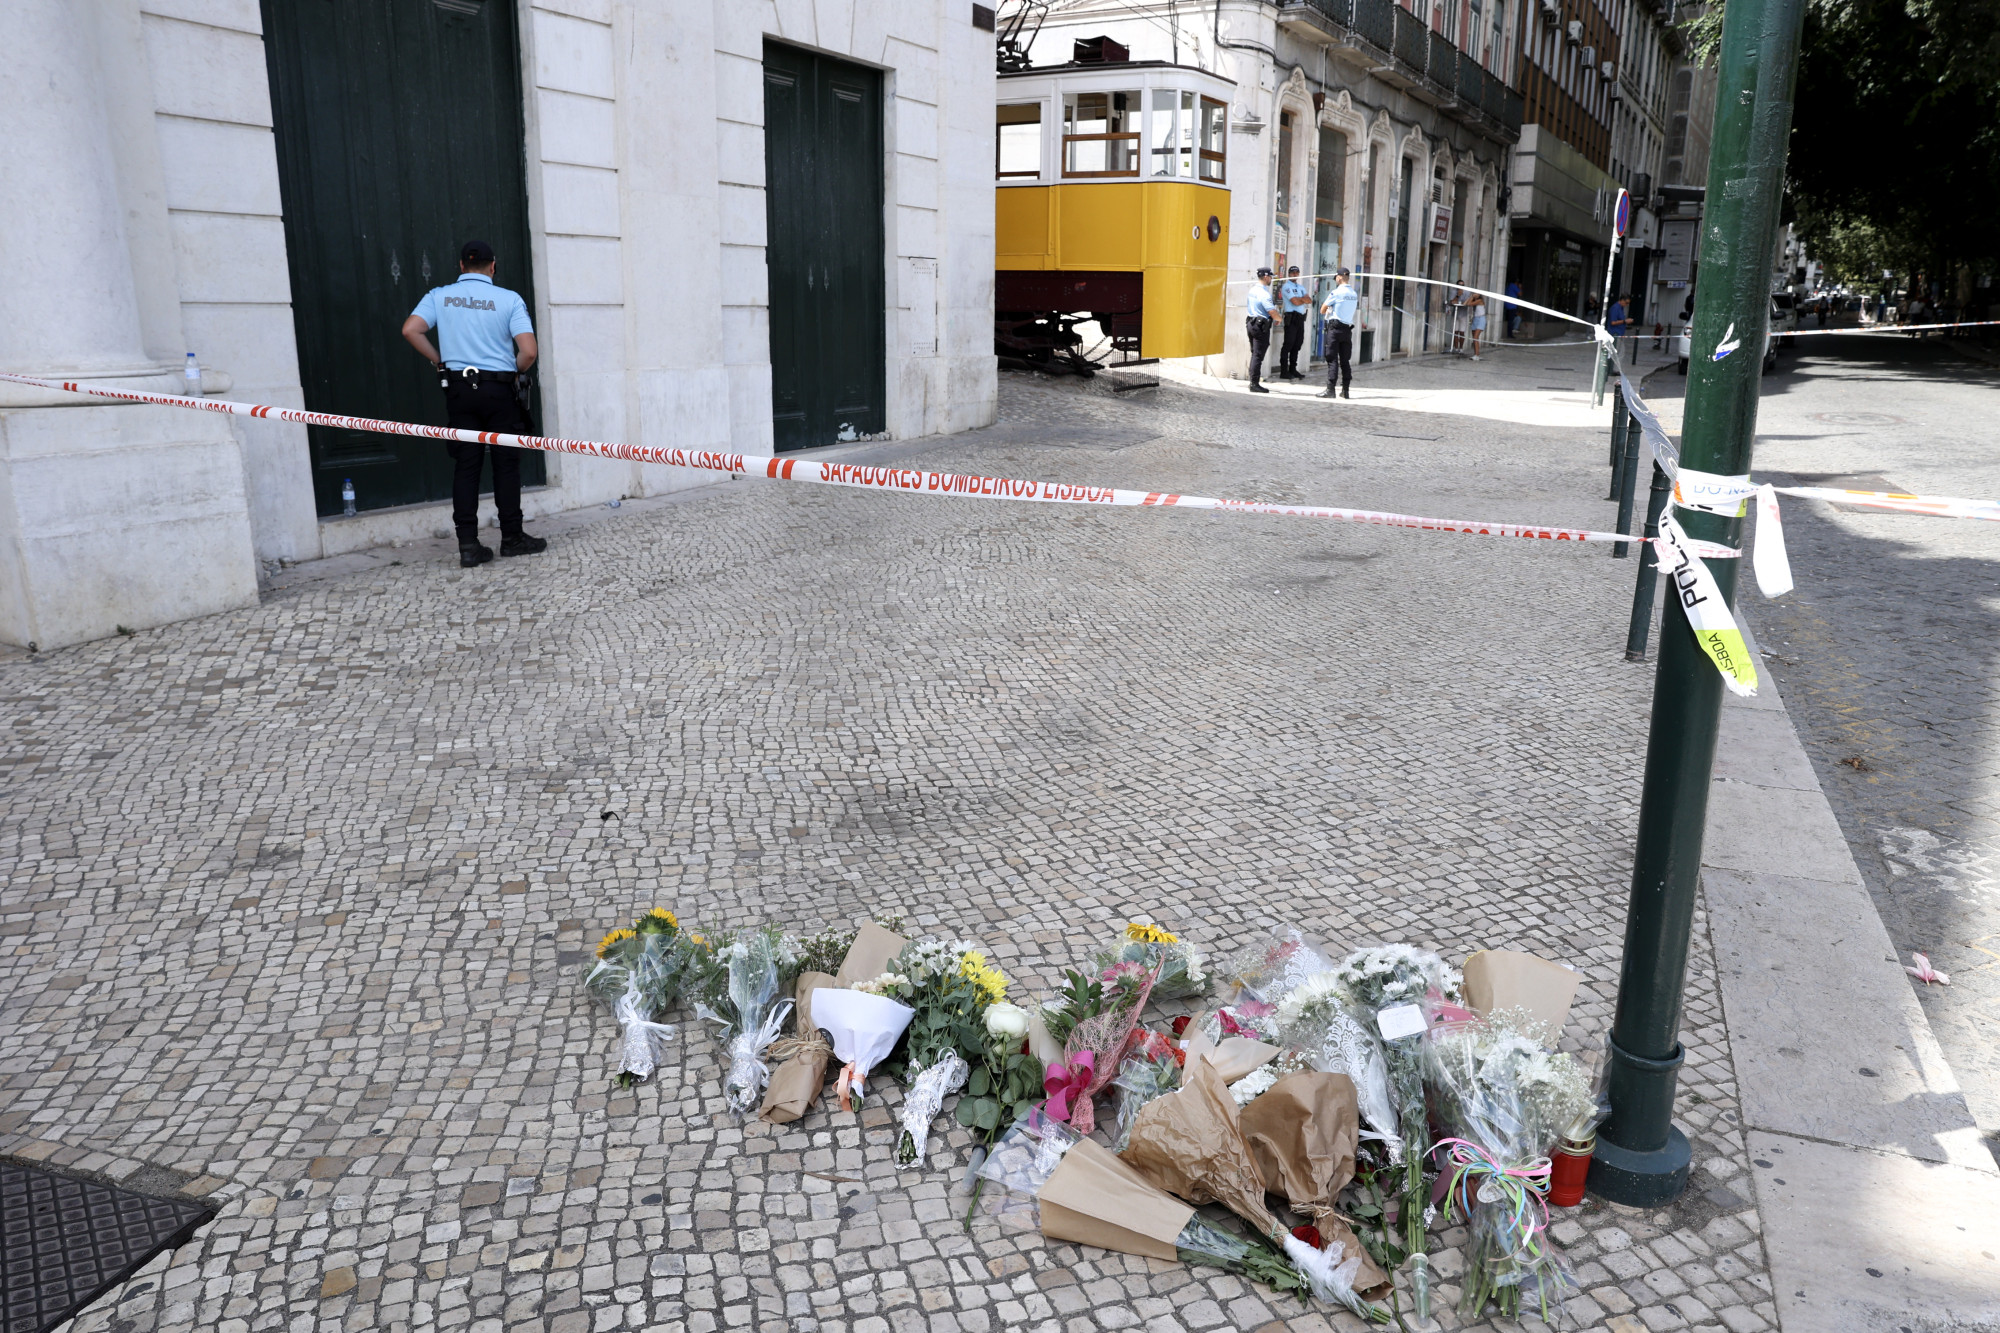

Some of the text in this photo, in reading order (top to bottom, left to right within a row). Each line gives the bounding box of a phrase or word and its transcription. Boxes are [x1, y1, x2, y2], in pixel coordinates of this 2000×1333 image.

[820, 462, 1114, 503] SAPADORES BOMBEIROS LISBOA
